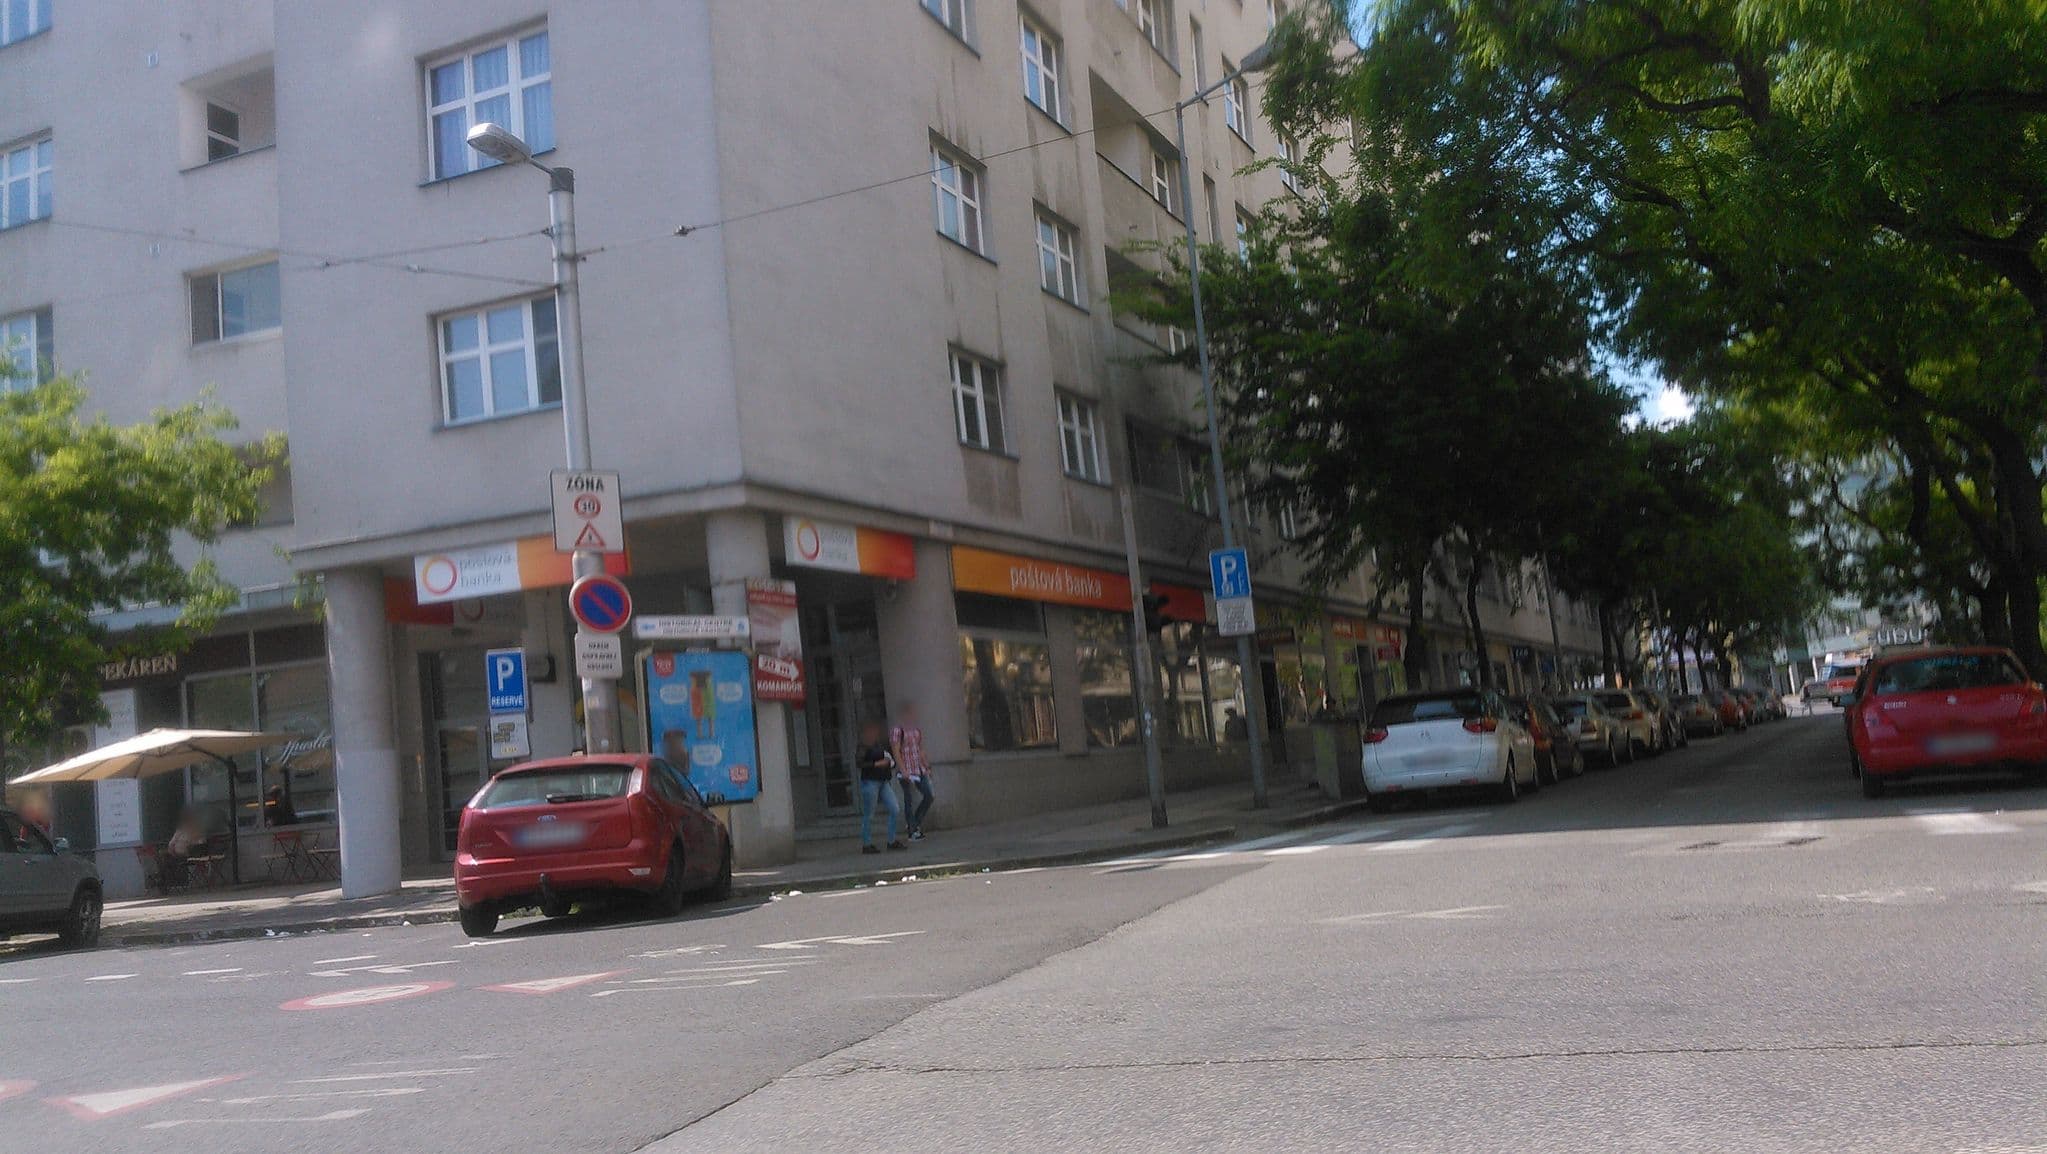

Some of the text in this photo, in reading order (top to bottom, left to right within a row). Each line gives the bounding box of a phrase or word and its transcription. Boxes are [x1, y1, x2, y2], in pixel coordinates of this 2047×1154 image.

[460, 571, 504, 588] banka
[1010, 562, 1102, 599] poštová banka
[496, 657, 515, 692] P
[756, 679, 803, 694] KOMANDOR
